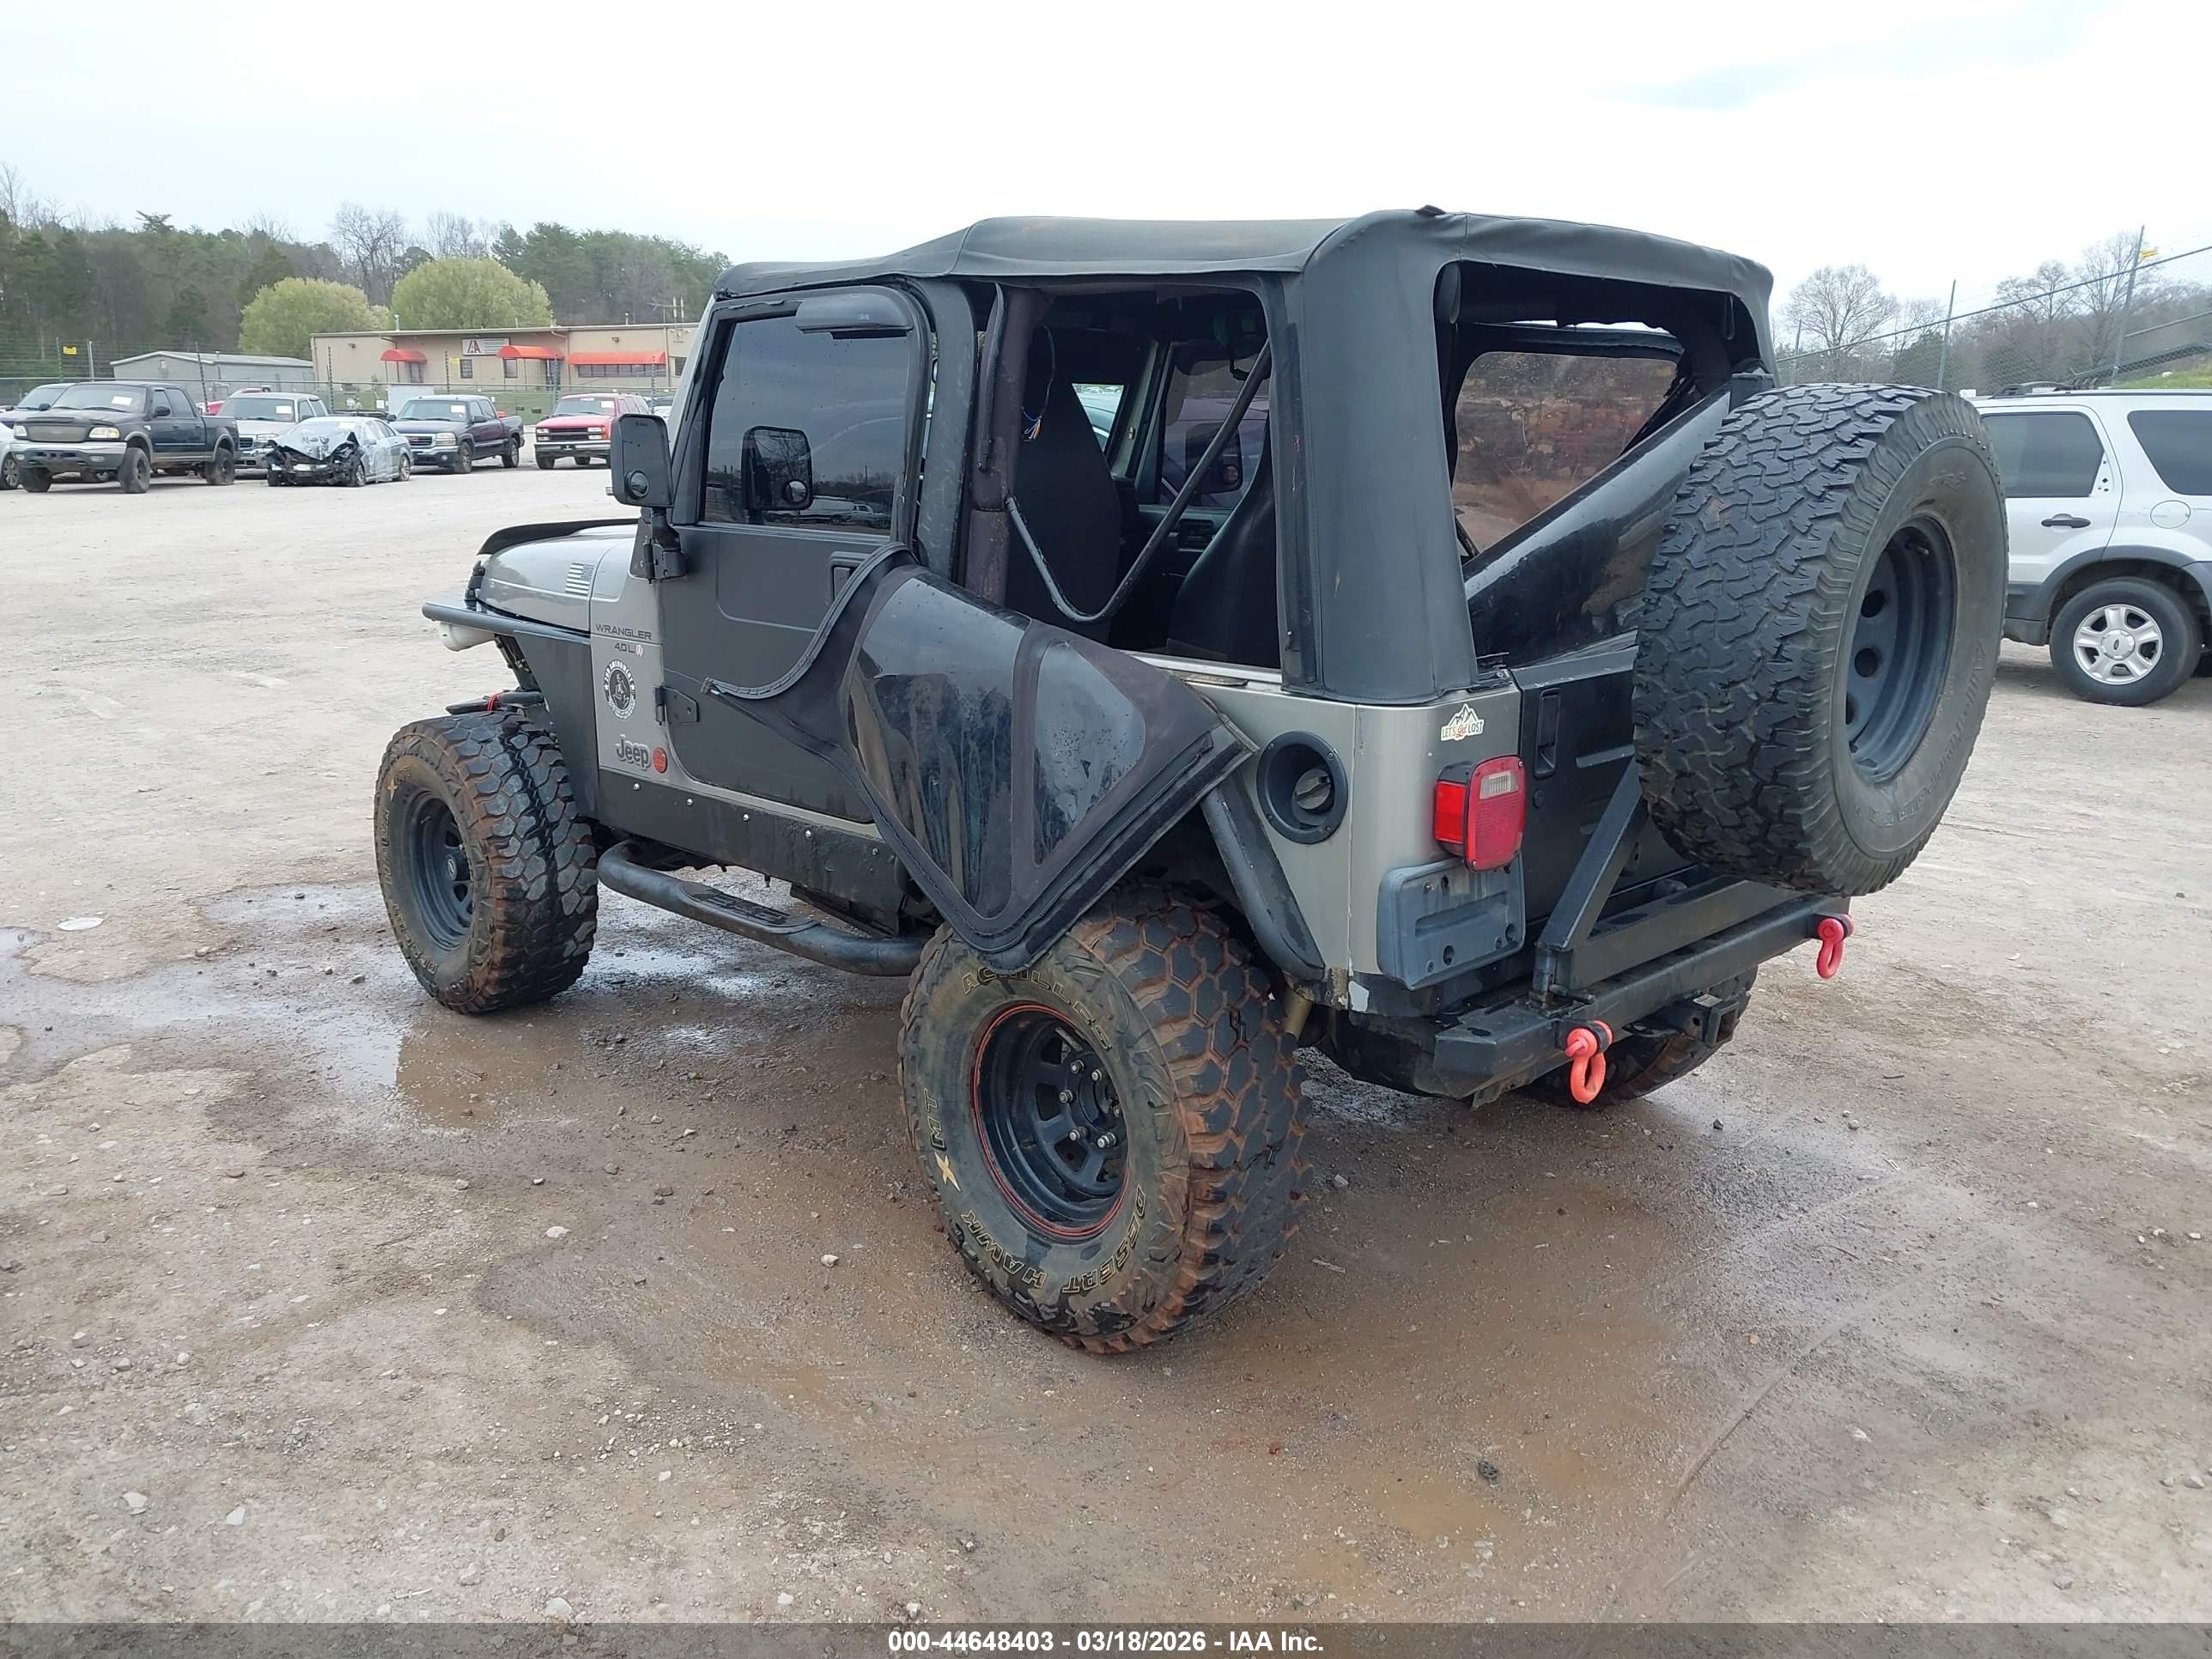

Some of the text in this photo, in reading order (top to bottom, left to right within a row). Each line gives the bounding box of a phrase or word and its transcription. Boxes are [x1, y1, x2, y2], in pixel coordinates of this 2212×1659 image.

[595, 623, 653, 641] WRANGLER
[616, 735, 650, 769] Jeep
[1468, 721, 1484, 733] LOST
[962, 967, 1113, 1050] ACILLES
[961, 1209, 1048, 1289] HAWK
[1062, 1183, 1146, 1293] DESERT
